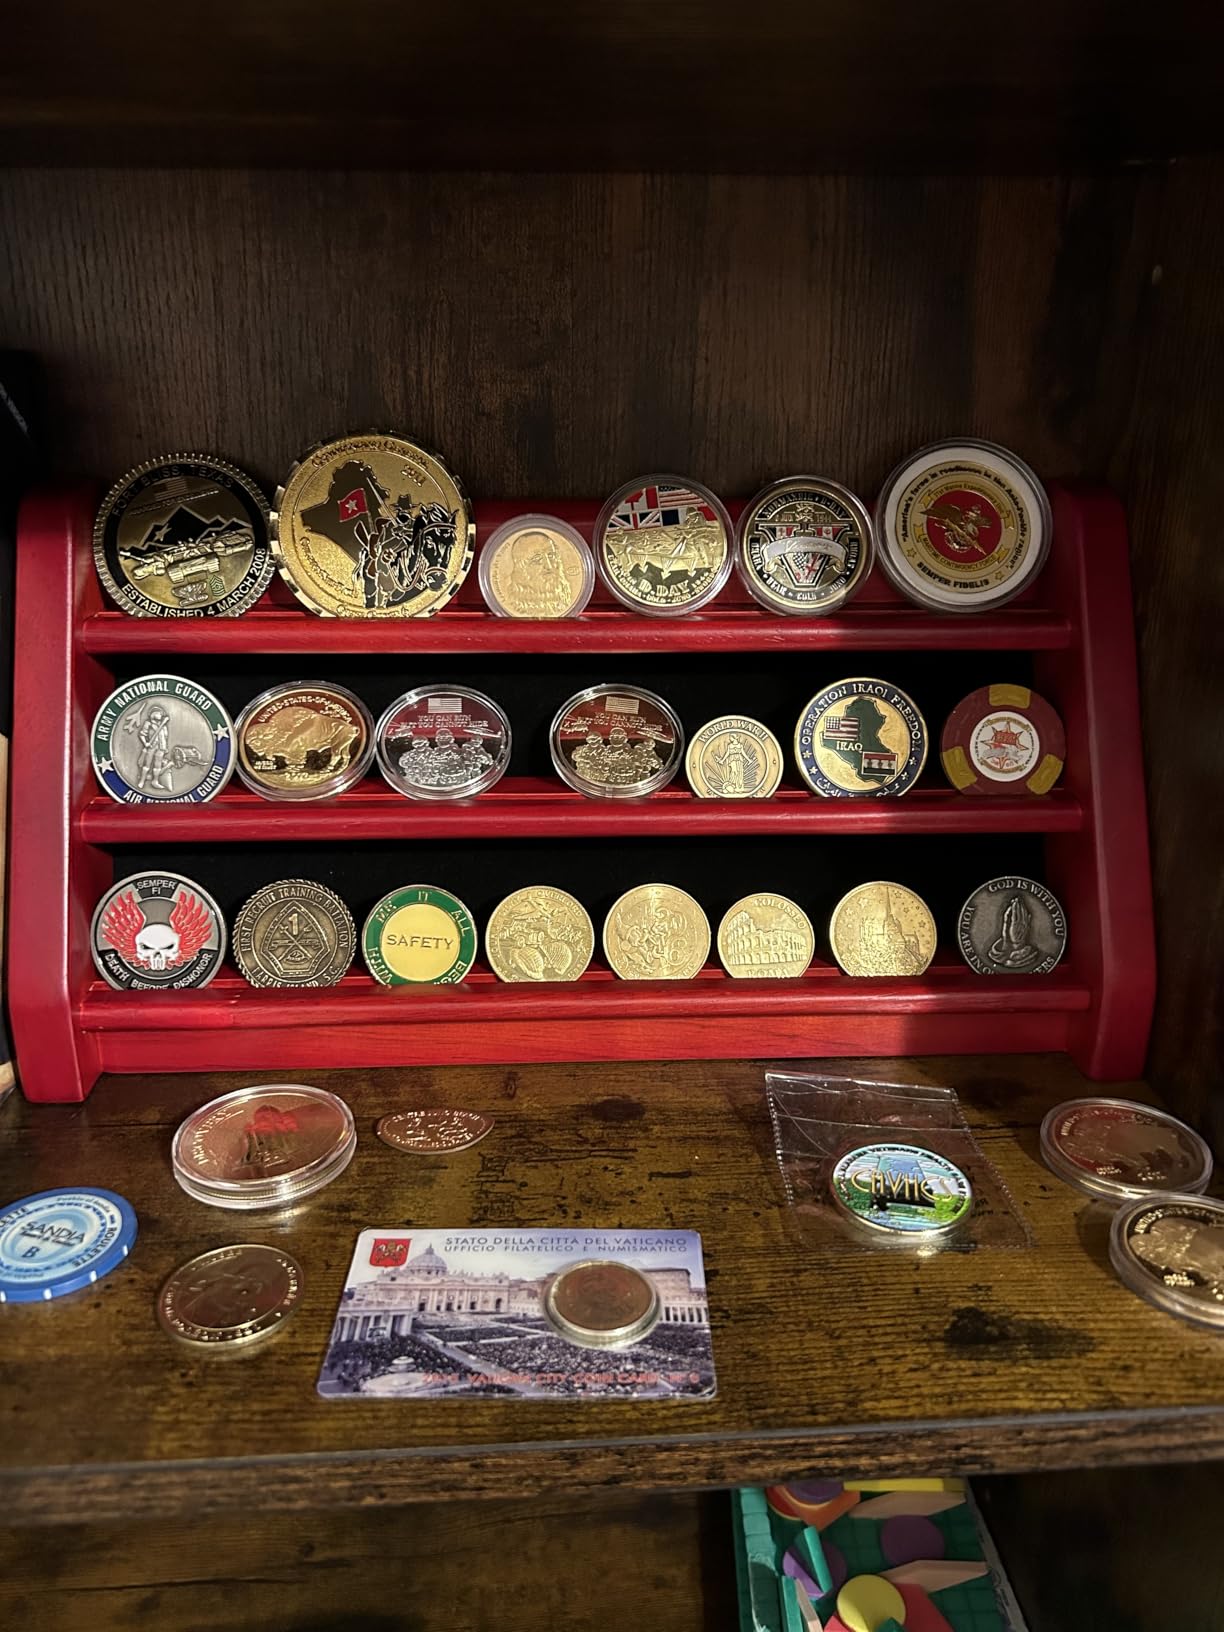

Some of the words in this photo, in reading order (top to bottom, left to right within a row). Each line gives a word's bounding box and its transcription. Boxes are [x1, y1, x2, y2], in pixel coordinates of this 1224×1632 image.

[190, 464, 233, 488] TEXAS
[122, 583, 204, 617] ESTABLISHED
[207, 606, 215, 615] 4
[217, 577, 255, 612] MARCH
[251, 548, 266, 576] 2008
[917, 562, 952, 586] SEMPER
[953, 578, 990, 589] FIDELIS
[96, 707, 117, 741] ARMY
[114, 681, 169, 708] NATIONAL
[175, 683, 212, 711] GUARD
[802, 687, 847, 745] OPERATION
[852, 683, 888, 697] IRAQI
[890, 695, 921, 752] FREEDOM
[698, 720, 734, 743] WORLD
[737, 720, 760, 737] WAR
[759, 733, 769, 741] II
[836, 741, 863, 753] IRAQ
[123, 790, 143, 803] AIR
[196, 765, 224, 797] GUARD
[136, 880, 177, 890] SEMPER
[418, 891, 429, 901] IT
[240, 926, 252, 952] FIRST
[246, 892, 276, 924] RECRUIT
[278, 887, 323, 901] TRAINING
[323, 900, 349, 948] BATTALION
[376, 900, 397, 922] ME
[753, 898, 807, 930] COLOSSEO
[961, 906, 976, 930] YOU
[988, 880, 1014, 892] GOD
[1017, 880, 1028, 889] IS
[1030, 884, 1057, 910] WITH
[1052, 911, 1064, 936] YOU
[288, 913, 298, 935] 1
[451, 909, 471, 937] ALL
[386, 934, 454, 950] SAFETY
[961, 932, 973, 956] ARE
[105, 953, 130, 981] DEATH
[173, 953, 213, 990] DISHONOR
[368, 947, 393, 983] WITH
[969, 955, 981, 969] IN
[24, 1221, 86, 1244] SANDIA
[446, 1237, 488, 1245] STATO
[493, 1237, 535, 1245] DELLA
[585, 1237, 609, 1246] DEL
[614, 1237, 687, 1246] VATICANO
[72, 1227, 117, 1267] ROULETTE
[599, 1245, 688, 1253] NUMISMATICO
[536, 1372, 567, 1384] CITY
